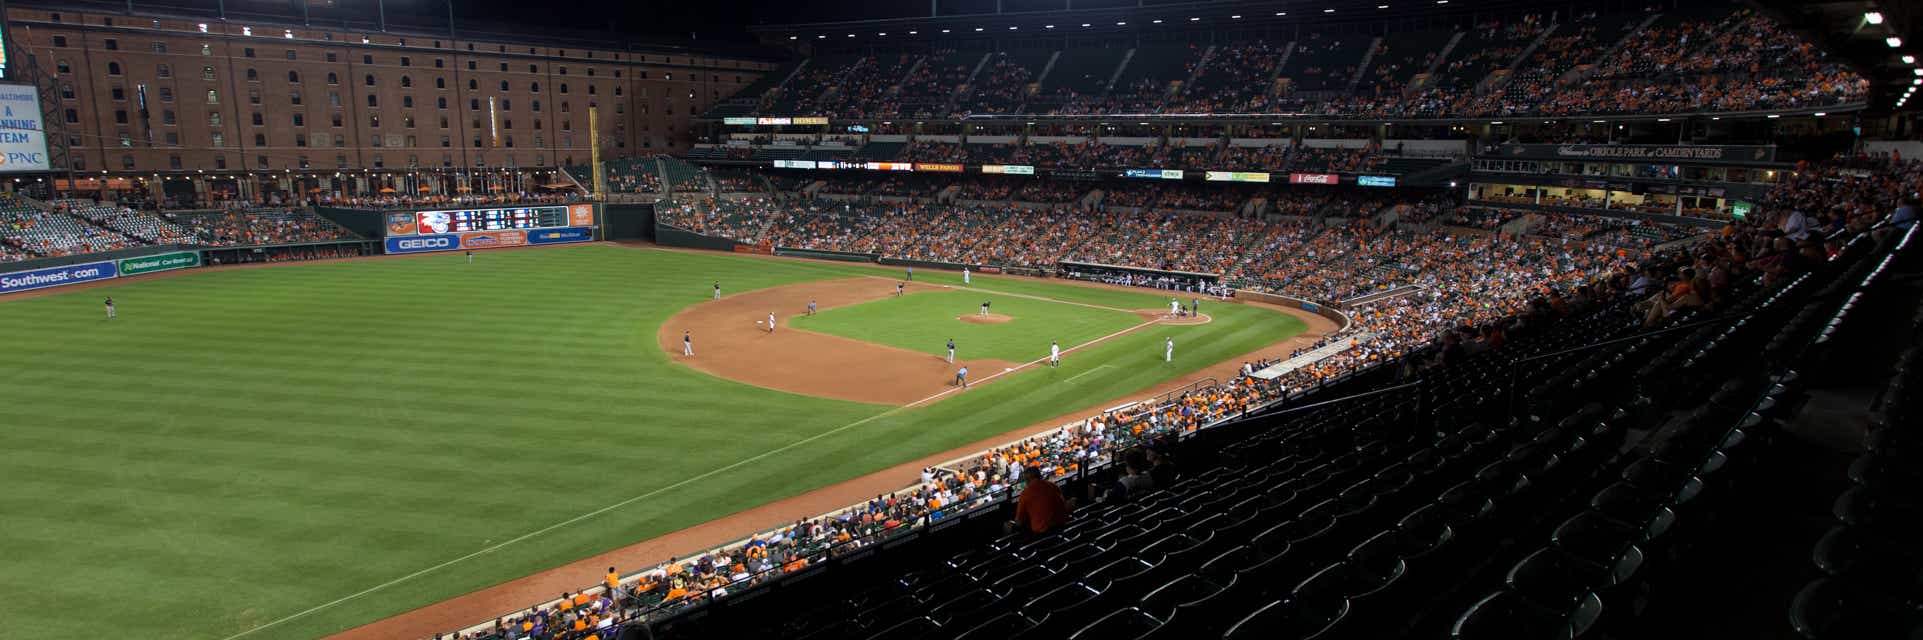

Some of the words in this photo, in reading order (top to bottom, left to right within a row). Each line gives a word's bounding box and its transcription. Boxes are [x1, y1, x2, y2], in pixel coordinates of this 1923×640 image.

[6, 106, 13, 117] A
[0, 120, 36, 129] NNING
[1590, 147, 1623, 157] ORIOLE
[1624, 147, 1647, 157] PARK
[1655, 148, 1693, 158] CAMDEN
[1695, 148, 1722, 158] YARDS
[8, 153, 43, 164] PNC
[399, 238, 449, 249] GEICO
[133, 260, 159, 270] National
